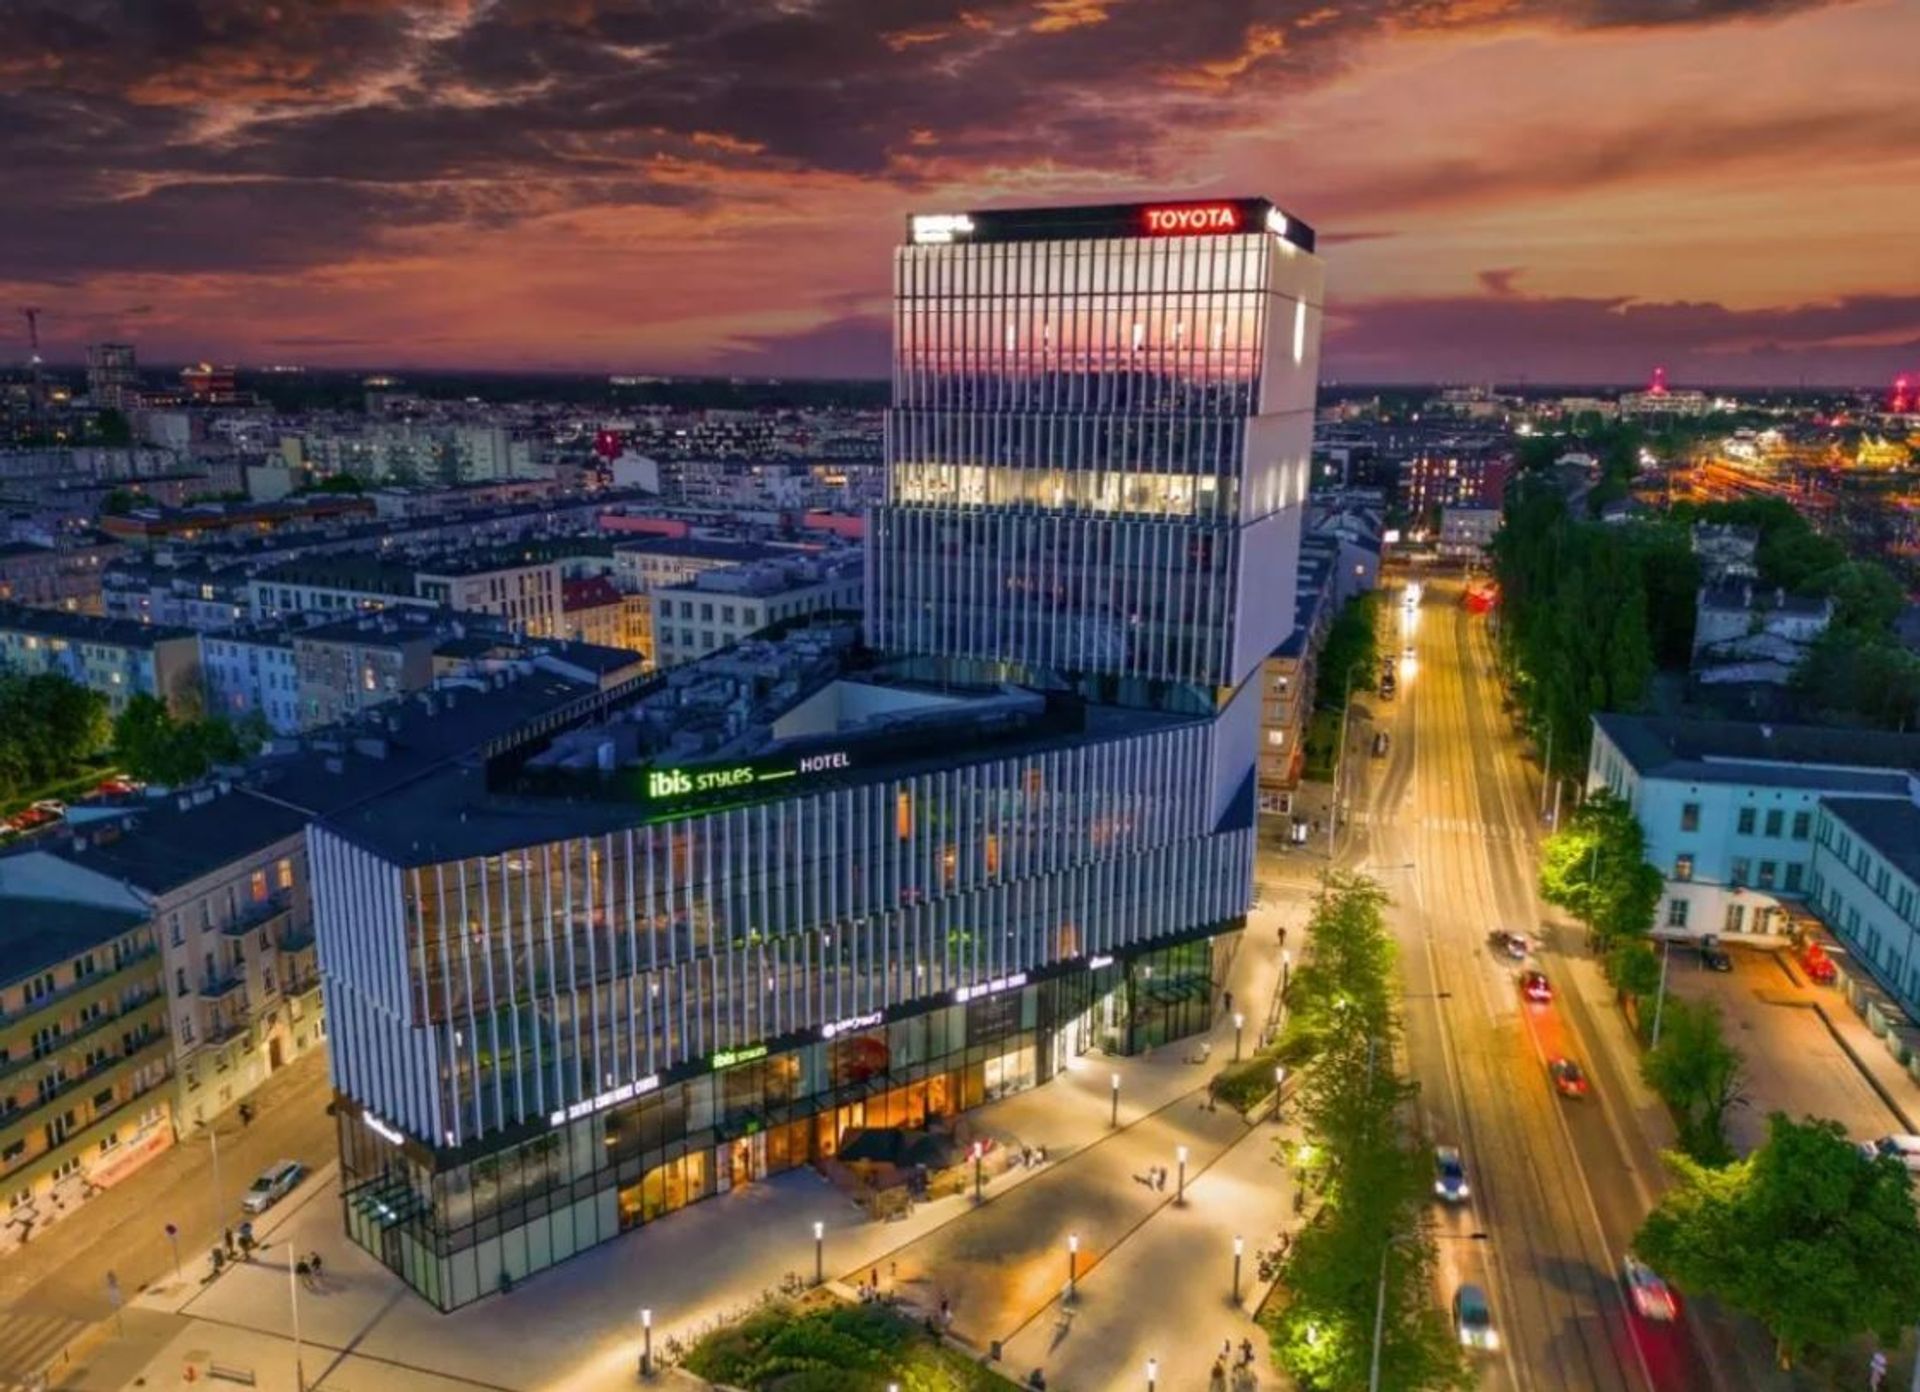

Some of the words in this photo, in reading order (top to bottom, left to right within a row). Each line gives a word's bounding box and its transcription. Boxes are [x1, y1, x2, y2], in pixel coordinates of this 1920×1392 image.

[1147, 208, 1236, 230] TOYOTA
[649, 769, 692, 797] ibis
[801, 752, 850, 773] HOTEL
